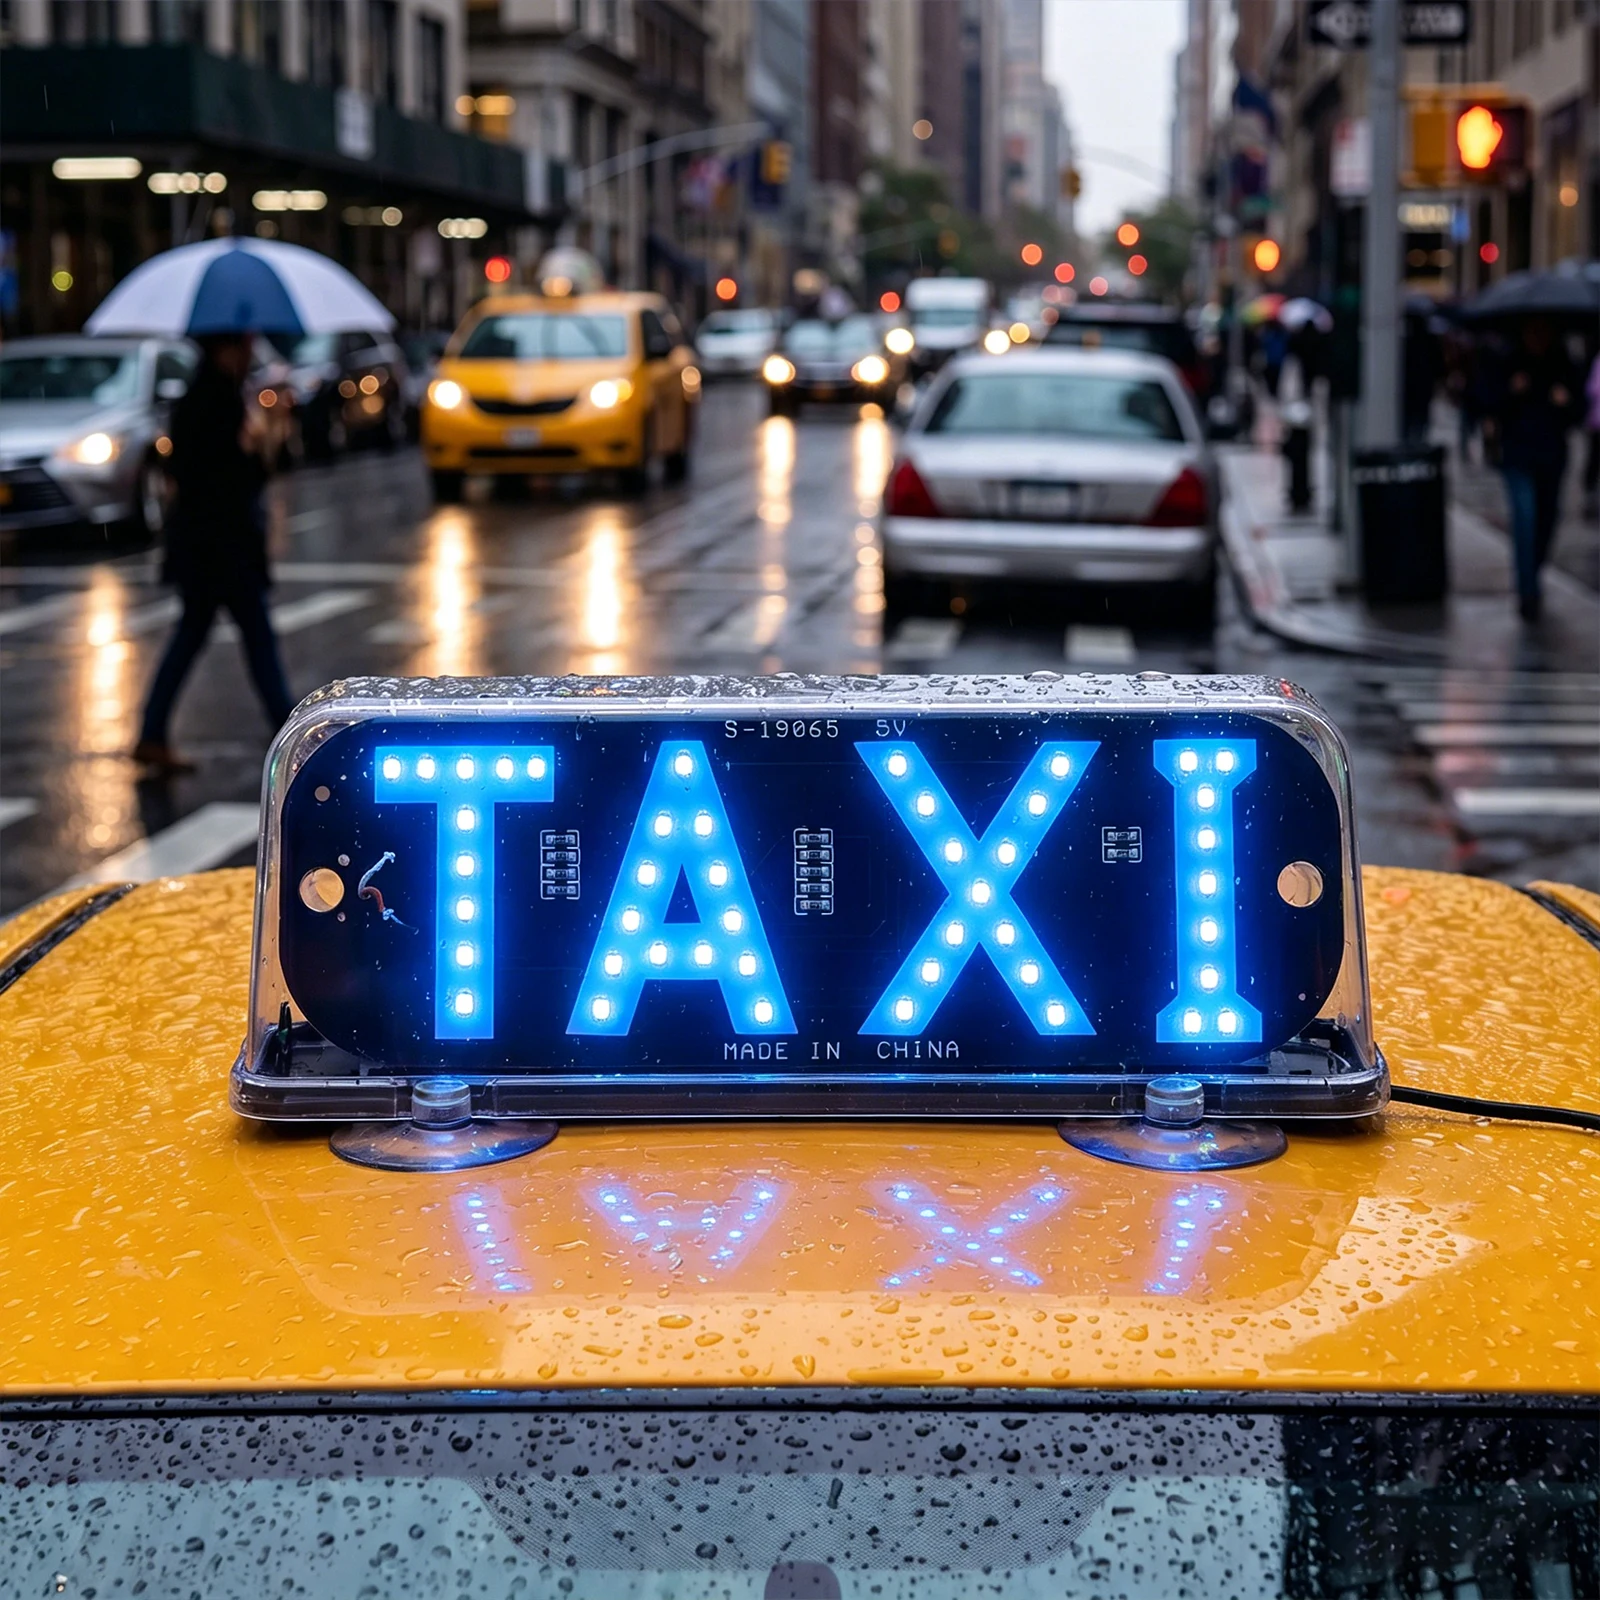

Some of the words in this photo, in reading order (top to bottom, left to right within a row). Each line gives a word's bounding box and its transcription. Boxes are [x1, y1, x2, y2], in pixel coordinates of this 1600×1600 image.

[724, 720, 839, 738] S-19065
[876, 719, 906, 737] 5V
[374, 739, 1263, 1043] TAXI
[724, 1042, 789, 1060] MADE
[811, 1042, 841, 1060] IN
[876, 1040, 960, 1059] CHINA
